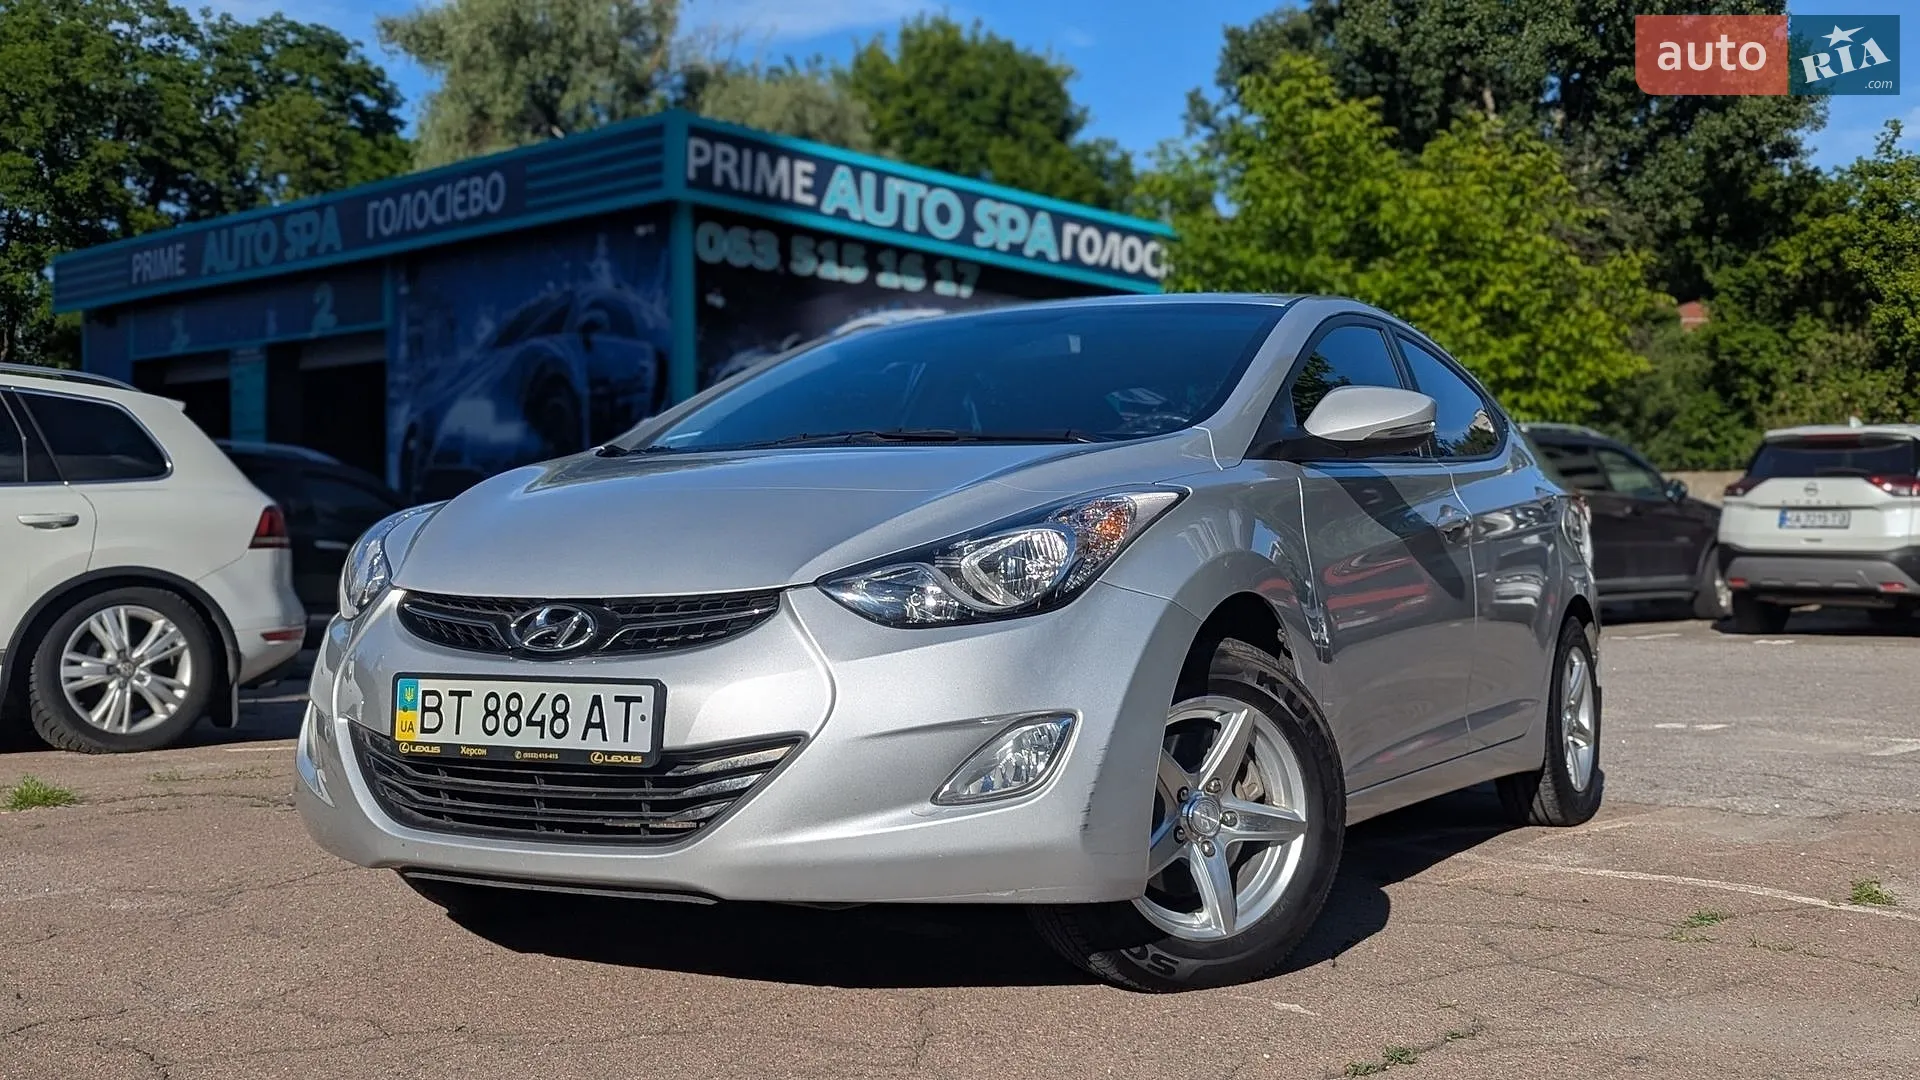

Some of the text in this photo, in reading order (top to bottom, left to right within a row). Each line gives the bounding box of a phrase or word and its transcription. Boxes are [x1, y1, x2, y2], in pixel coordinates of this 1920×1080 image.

[687, 137, 1168, 279] PRIME AUTO SPA ГОЛОС
[131, 244, 187, 286] PRIME
[201, 218, 279, 277] AUTO
[284, 206, 343, 262] SPA
[420, 689, 643, 743] BT 8848 AT
[400, 720, 415, 733] UA
[410, 745, 441, 754] LEXUS
[460, 745, 487, 757] Херсон
[603, 754, 642, 764] LEXUS
